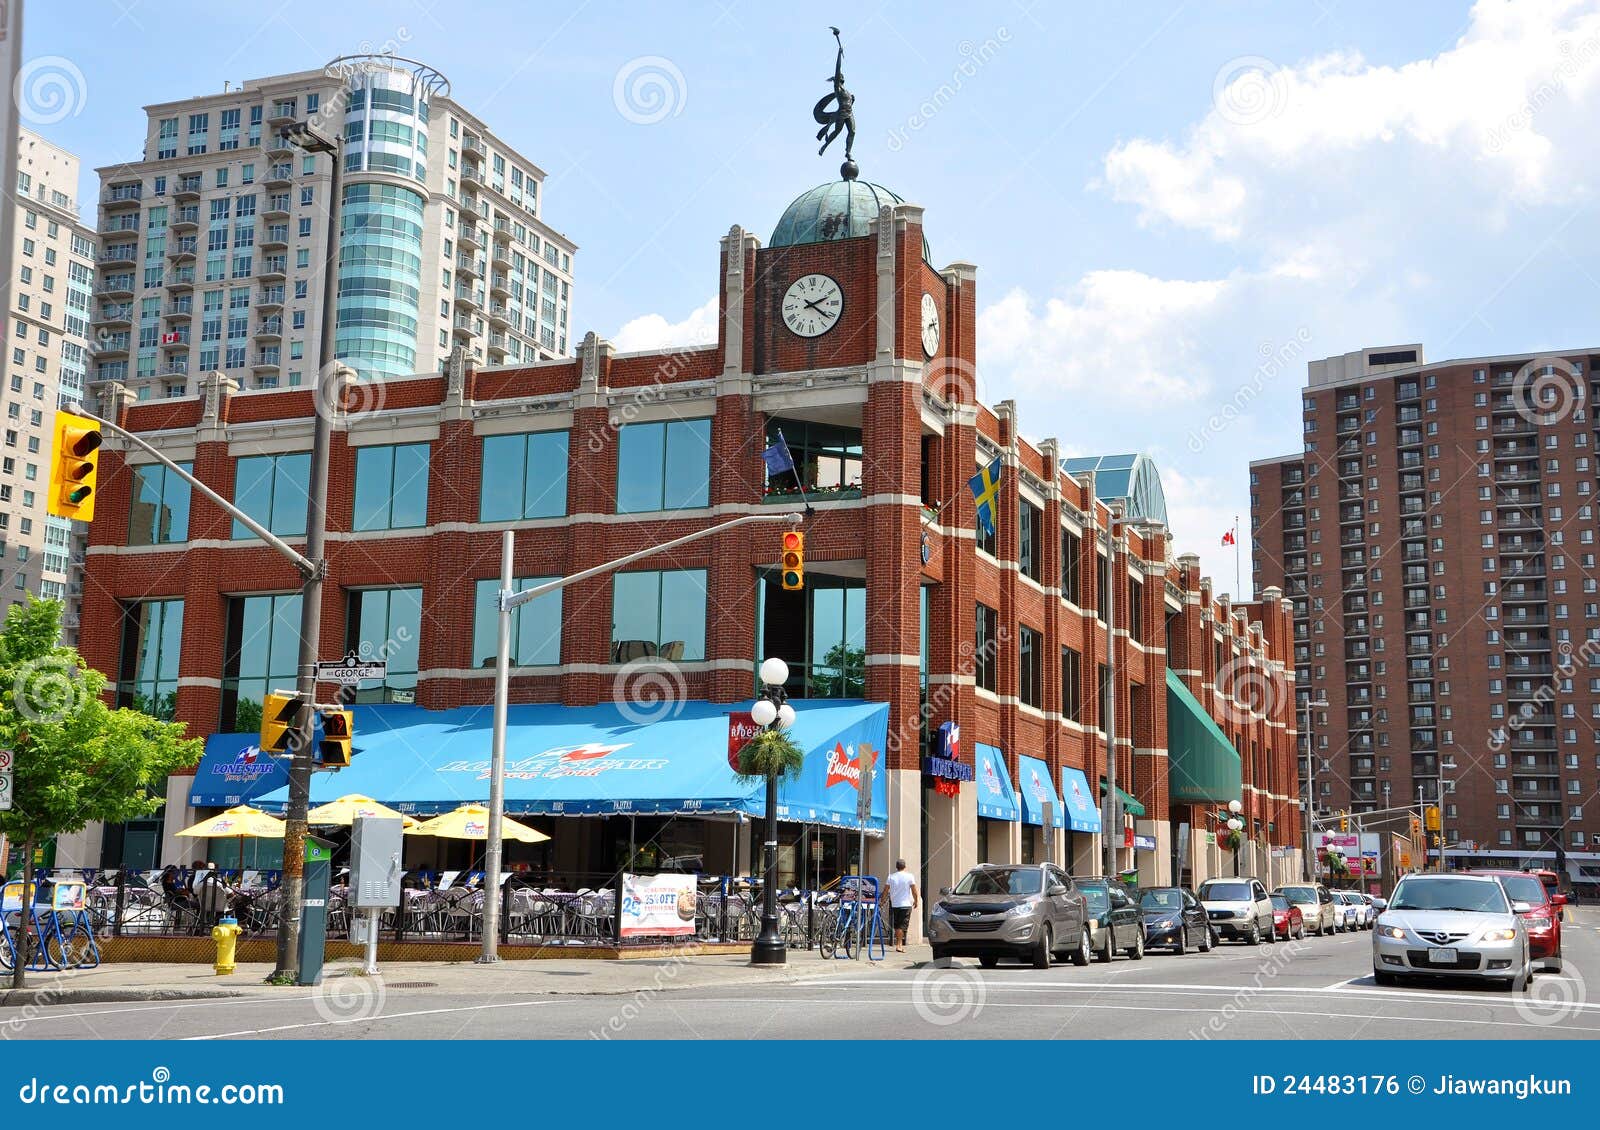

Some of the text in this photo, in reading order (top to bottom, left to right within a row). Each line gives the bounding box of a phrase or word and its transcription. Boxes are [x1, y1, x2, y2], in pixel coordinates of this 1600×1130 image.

[335, 669, 370, 678] GEORGE
[212, 763, 275, 775] LONE STAR
[826, 750, 878, 781] Budwer
